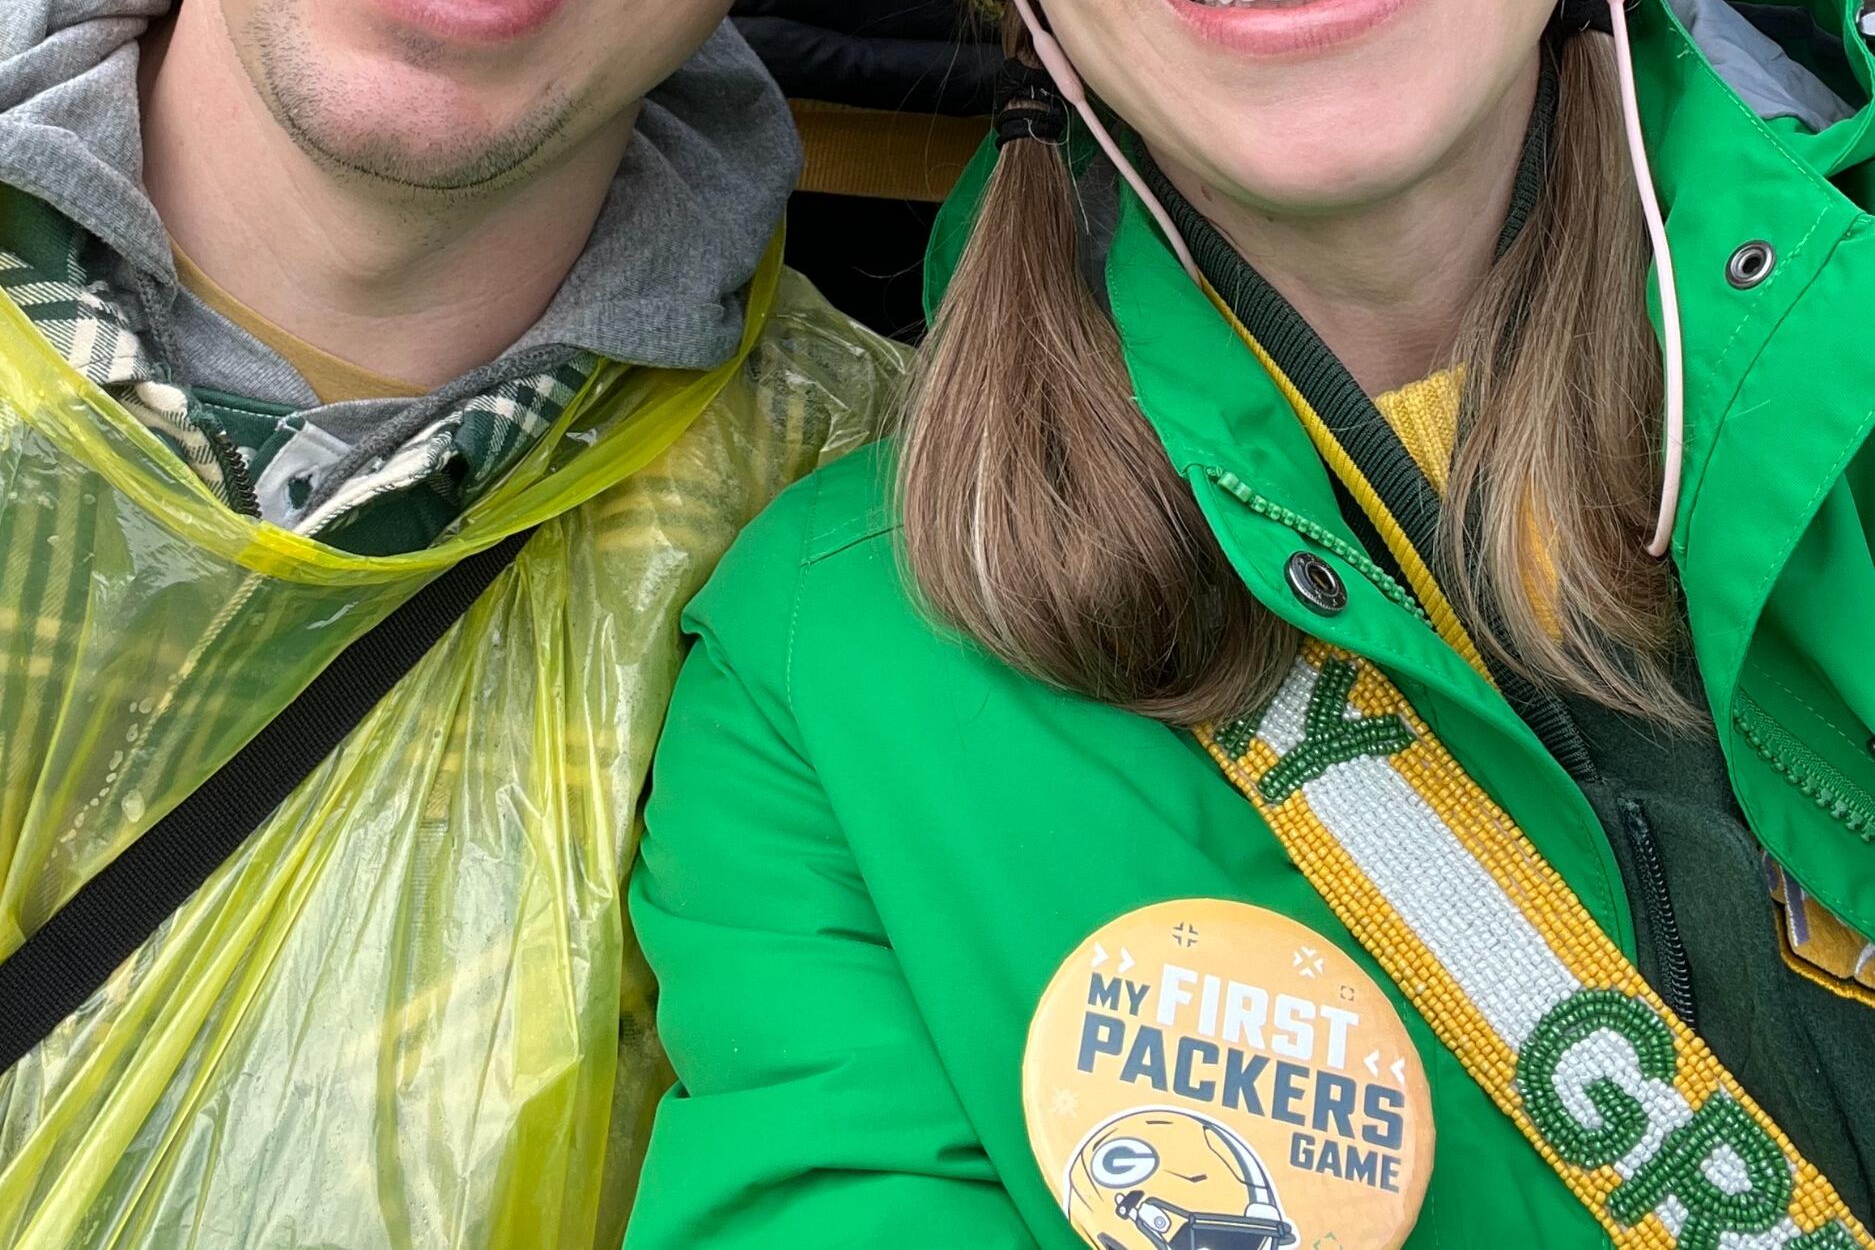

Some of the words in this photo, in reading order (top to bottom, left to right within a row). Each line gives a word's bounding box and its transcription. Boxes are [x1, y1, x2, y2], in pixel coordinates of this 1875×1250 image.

[1087, 971, 1150, 1017] MY
[1156, 963, 1360, 1070] FIRST
[1077, 1010, 1406, 1151] PACKERS
[1516, 988, 1858, 1250] GR
[1289, 1131, 1402, 1194] GAME
